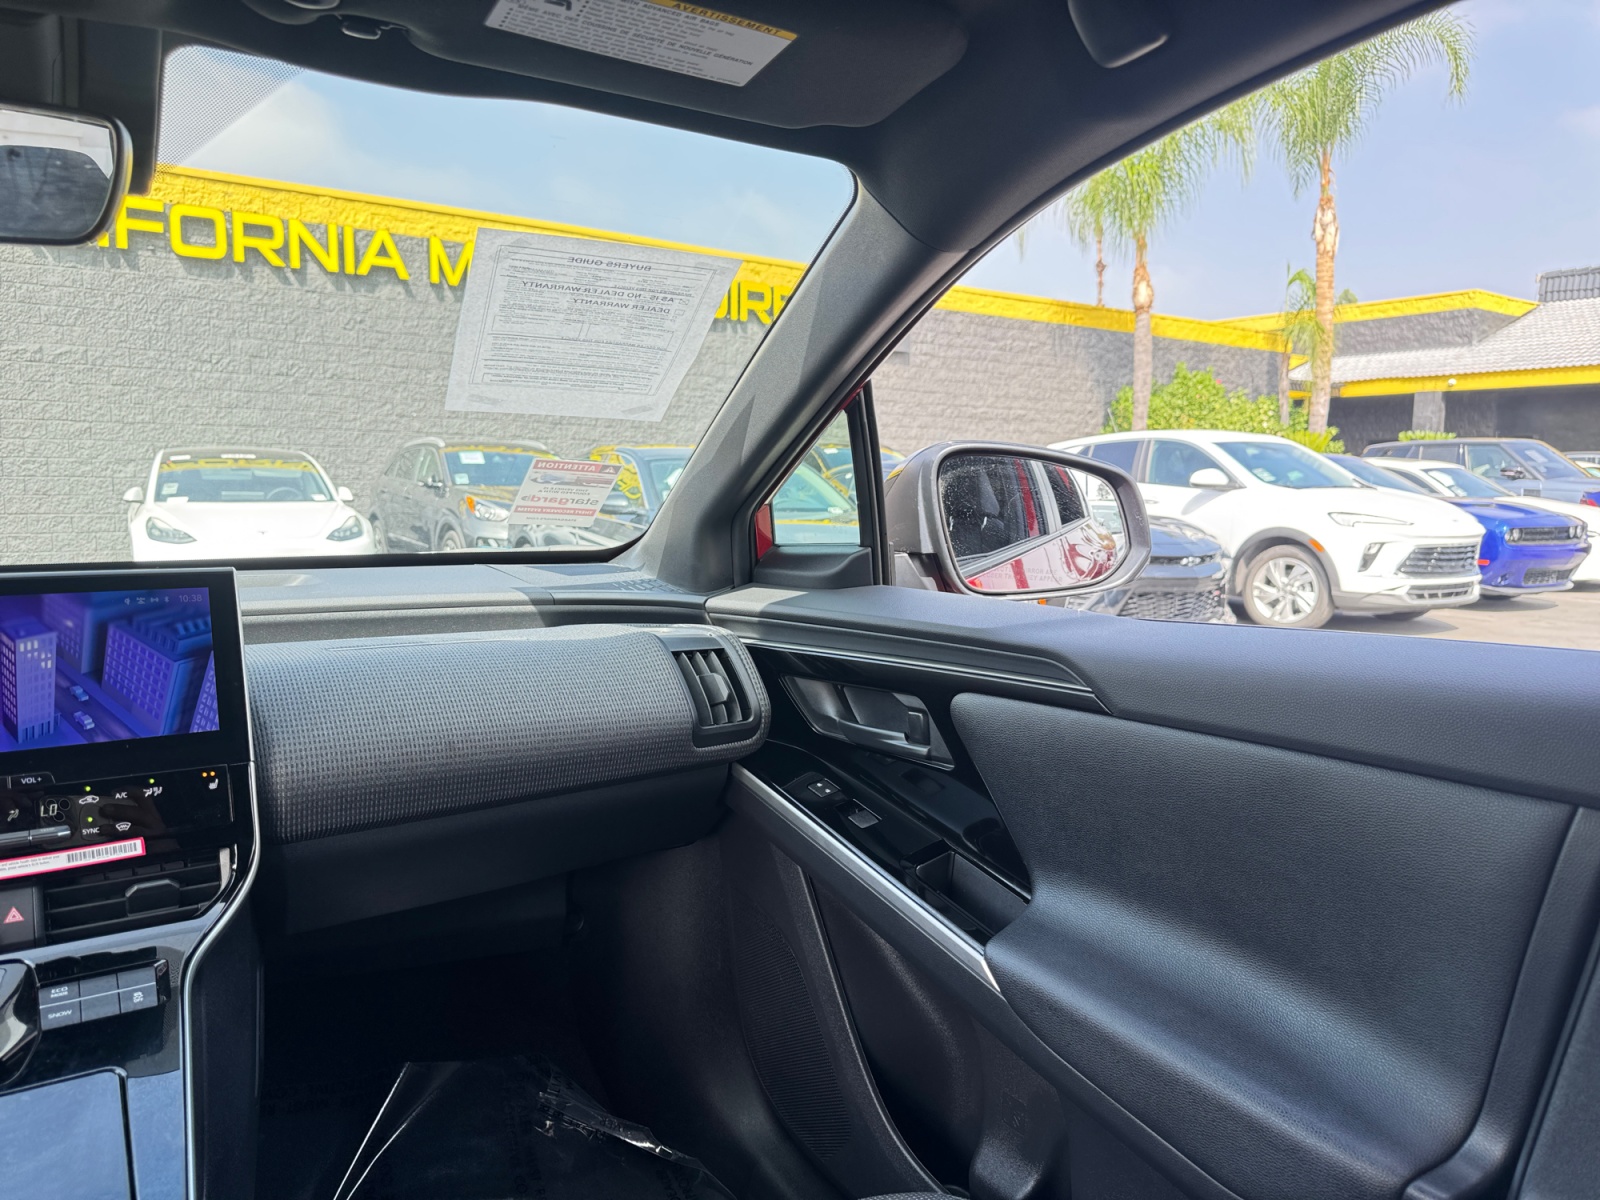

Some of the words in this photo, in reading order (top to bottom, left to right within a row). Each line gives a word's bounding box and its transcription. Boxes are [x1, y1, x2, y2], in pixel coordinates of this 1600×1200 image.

[642, 3, 682, 17] ADVANCED
[684, 13, 698, 21] AIR
[671, 2, 782, 36] AVERTISSEMENT
[582, 20, 618, 33] COUSSINS
[631, 31, 665, 45] SÉCURITÉ
[678, 43, 713, 56] NOUVELLE
[713, 52, 754, 66] GÉNÉRATION
[98, 195, 411, 281] FORNIA
[178, 594, 203, 603] 10:38
[115, 791, 128, 799] A/C
[82, 826, 100, 836] SYNC
[50, 986, 69, 994] ECO
[47, 1009, 73, 1019] SNOW
